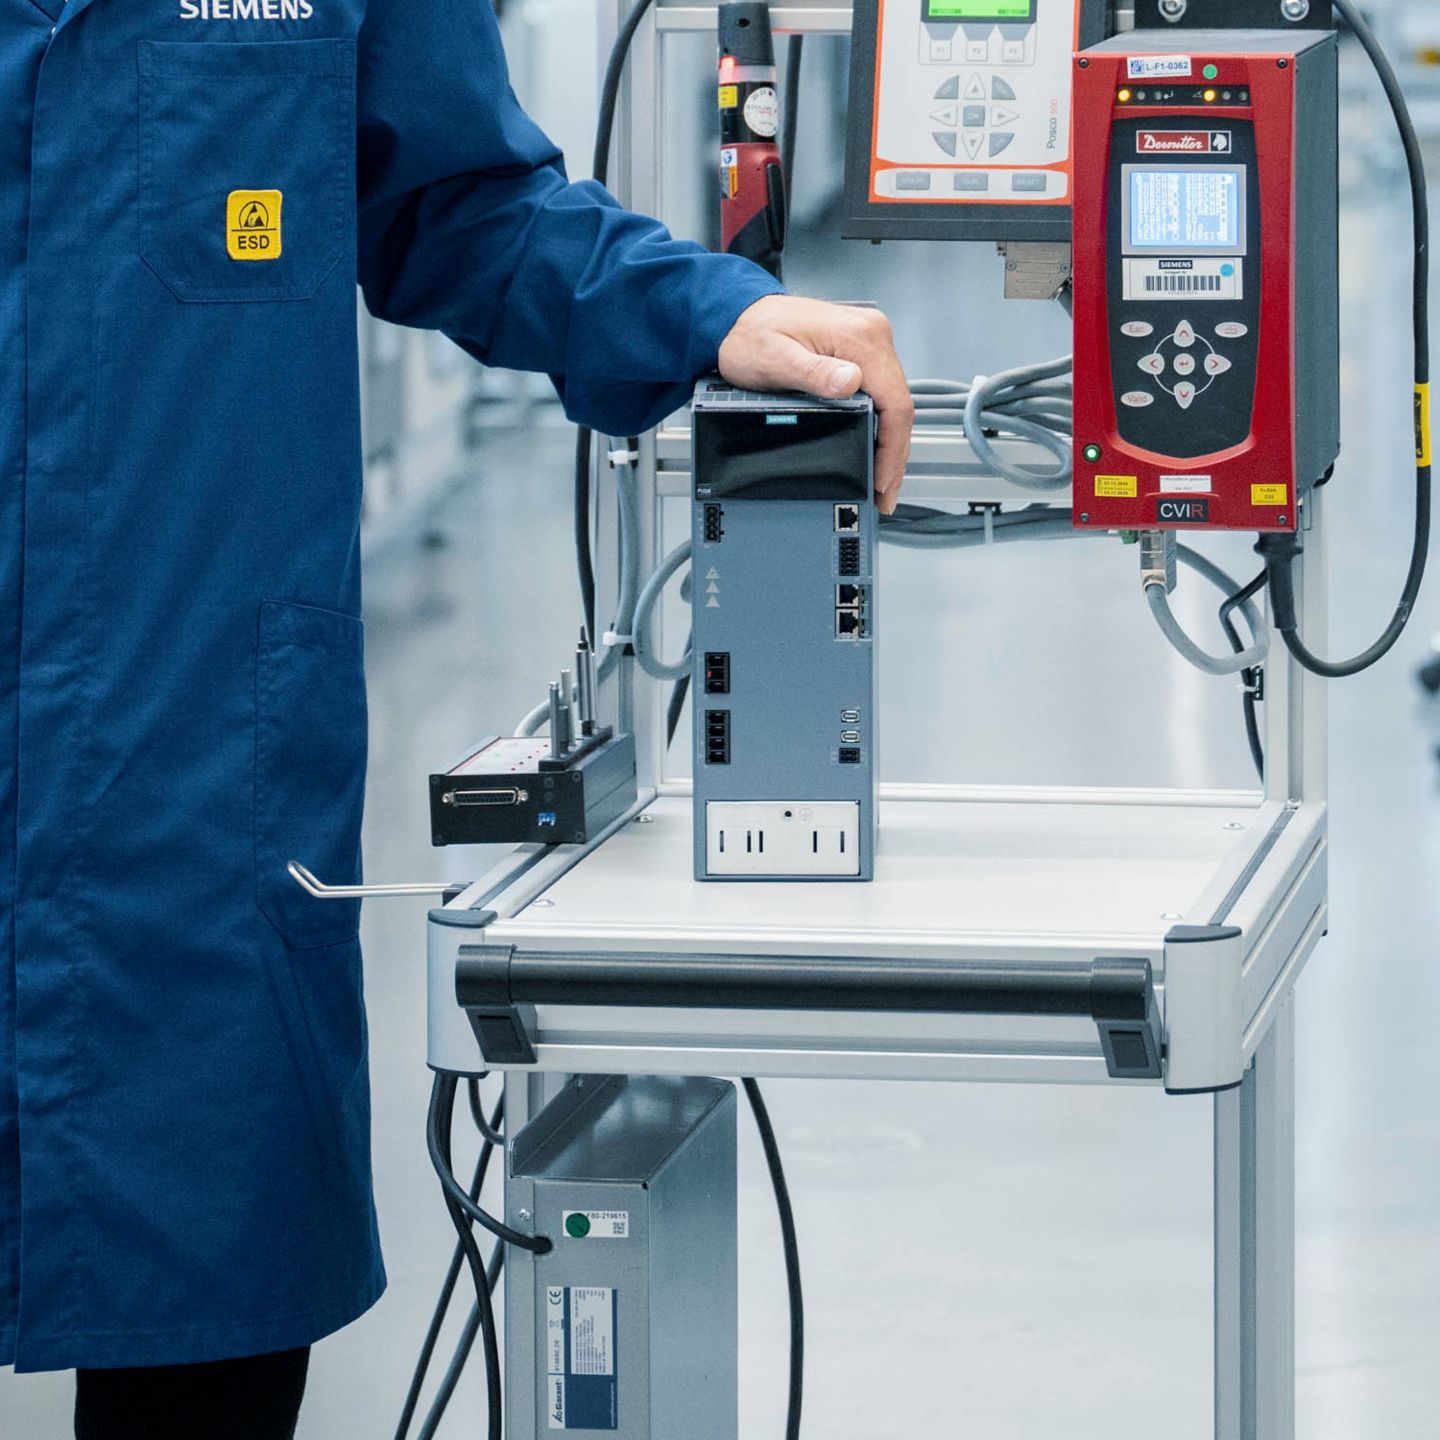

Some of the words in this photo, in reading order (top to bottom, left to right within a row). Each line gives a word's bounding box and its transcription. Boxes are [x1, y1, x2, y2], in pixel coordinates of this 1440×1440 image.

[1046, 117, 1058, 149] Posco
[1144, 134, 1204, 150] Desoutter
[237, 234, 270, 250] ESD
[1128, 325, 1144, 333] Esc
[1127, 394, 1147, 403] Valid
[1160, 502, 1204, 518] CVIR
[554, 1382, 563, 1410] Garant
